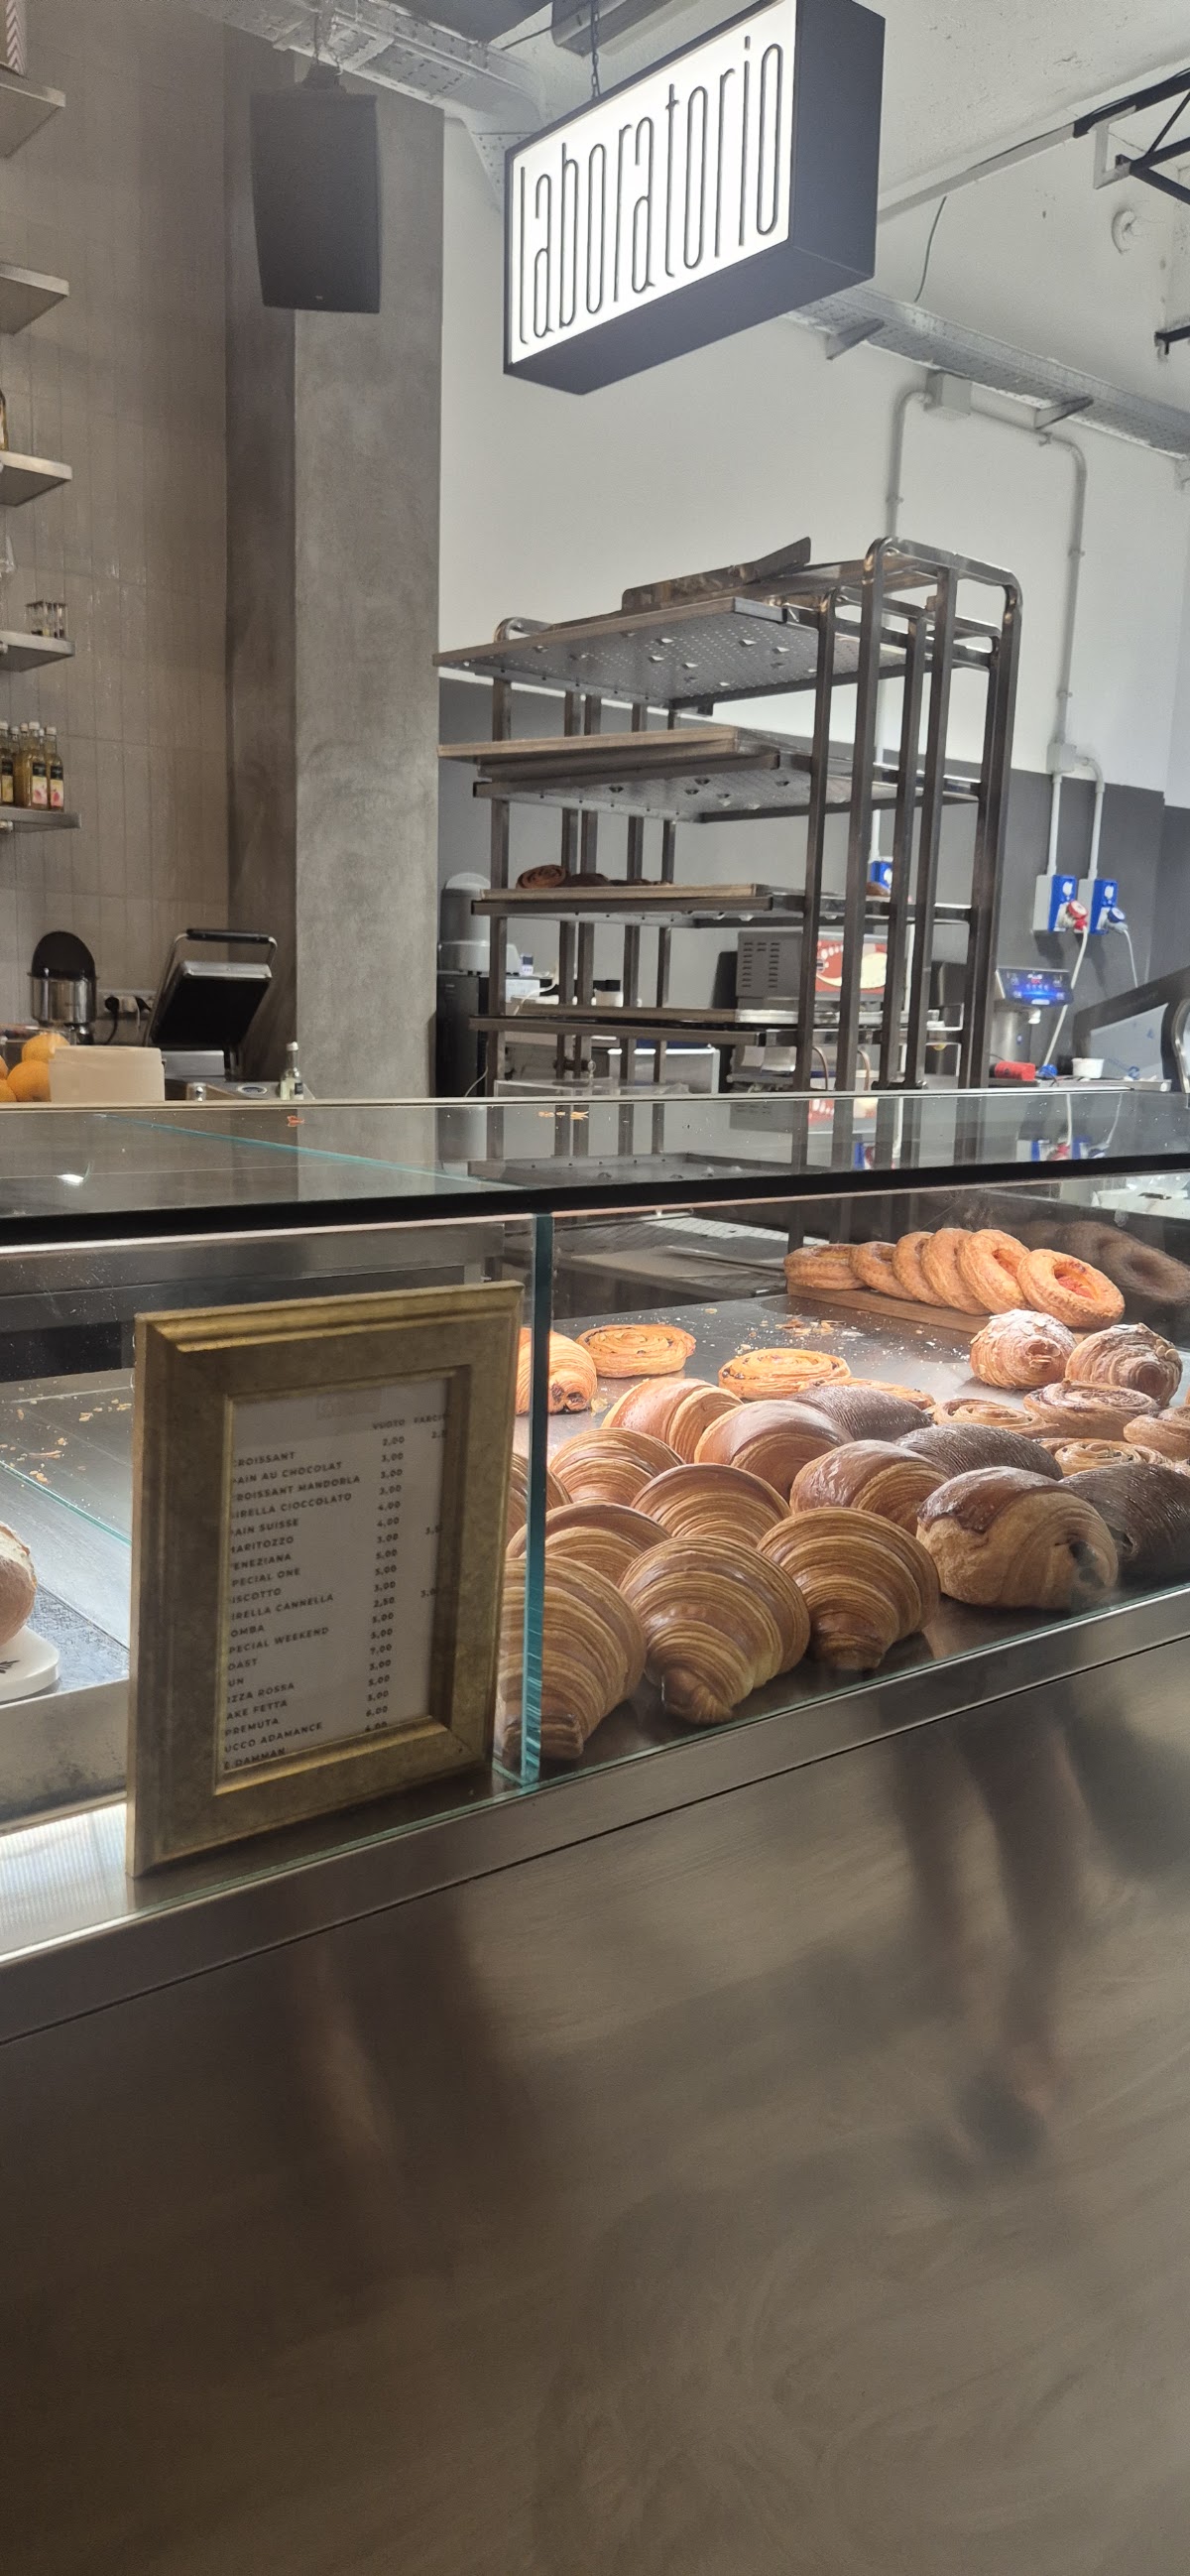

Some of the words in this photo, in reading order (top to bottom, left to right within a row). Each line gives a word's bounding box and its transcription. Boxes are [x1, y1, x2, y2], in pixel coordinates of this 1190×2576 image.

[519, 35, 784, 345] laboratorio
[261, 1471, 278, 1481] AU
[282, 1461, 342, 1478] CHOCOLAT
[234, 1485, 294, 1502] ROISSANT
[298, 1475, 360, 1492] MANDORLA
[233, 1506, 276, 1519] IRELLA
[281, 1492, 352, 1512] CIOCCOLATO
[259, 1518, 299, 1532] SUISSE
[233, 1553, 292, 1570] ENEZIANA
[231, 1573, 273, 1587] PECIAL
[277, 1567, 300, 1579] ONE
[231, 1587, 282, 1604] ISCOTTO
[231, 1606, 272, 1621] IRELLA
[275, 1593, 334, 1612] CANNELLA
[228, 1640, 270, 1654] PECIAL
[274, 1627, 329, 1645] WEEKEND
[230, 1625, 265, 1638] OMBA
[228, 1658, 257, 1671] OAST
[228, 1677, 244, 1687] UN
[226, 1691, 254, 1704] IZZA
[258, 1682, 295, 1697] ROSSA
[226, 1707, 249, 1721] AKE
[253, 1699, 288, 1713] FETTA
[224, 1739, 256, 1753] UCCO
[260, 1721, 322, 1744] ADAMANCE
[225, 1717, 280, 1737] PREMUTA
[235, 1747, 286, 1767] DAMMAN
